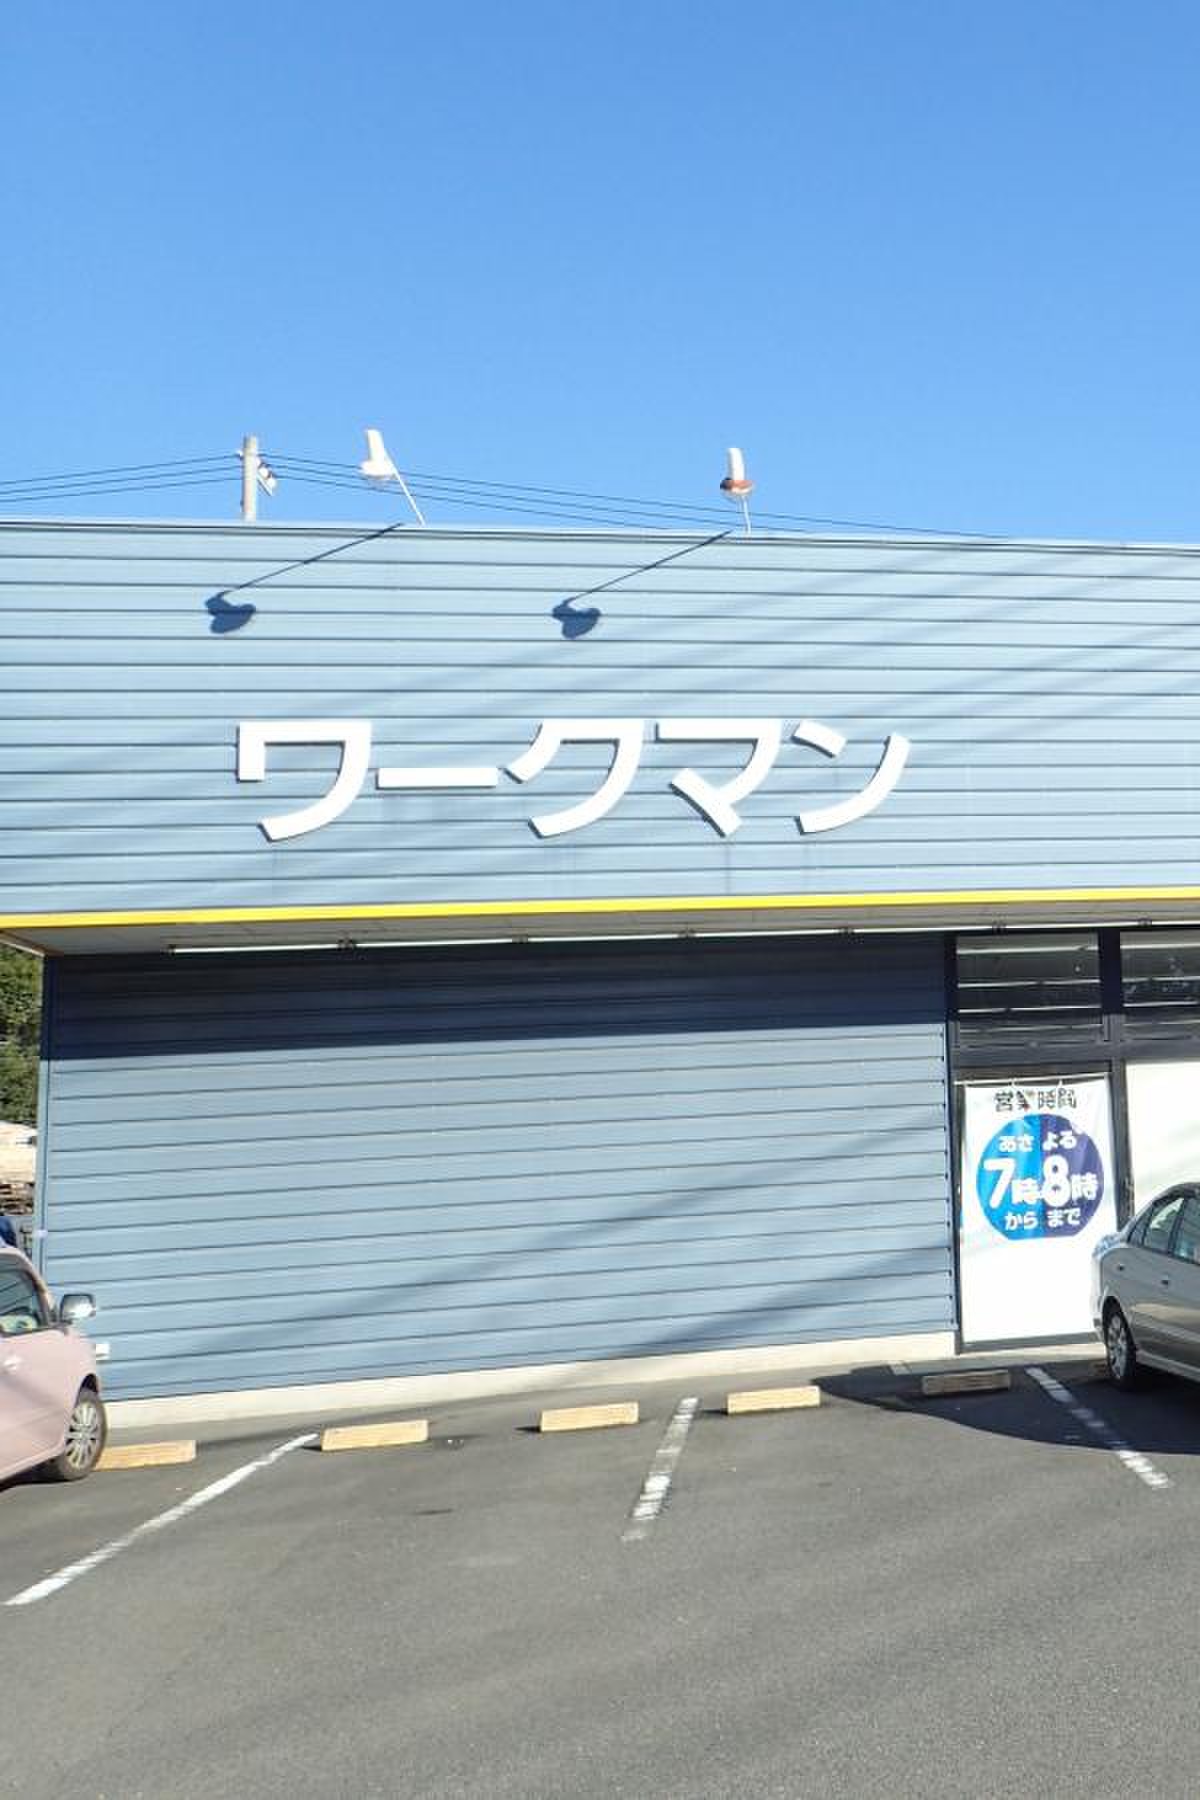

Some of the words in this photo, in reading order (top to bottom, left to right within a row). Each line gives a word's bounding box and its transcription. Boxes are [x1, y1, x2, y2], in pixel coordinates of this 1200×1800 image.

[235, 720, 911, 842] ワークマン
[999, 1134, 1034, 1152] あさ
[1043, 1130, 1077, 1150] よる
[1005, 1211, 1039, 1230] から
[1047, 1207, 1082, 1228] まで
